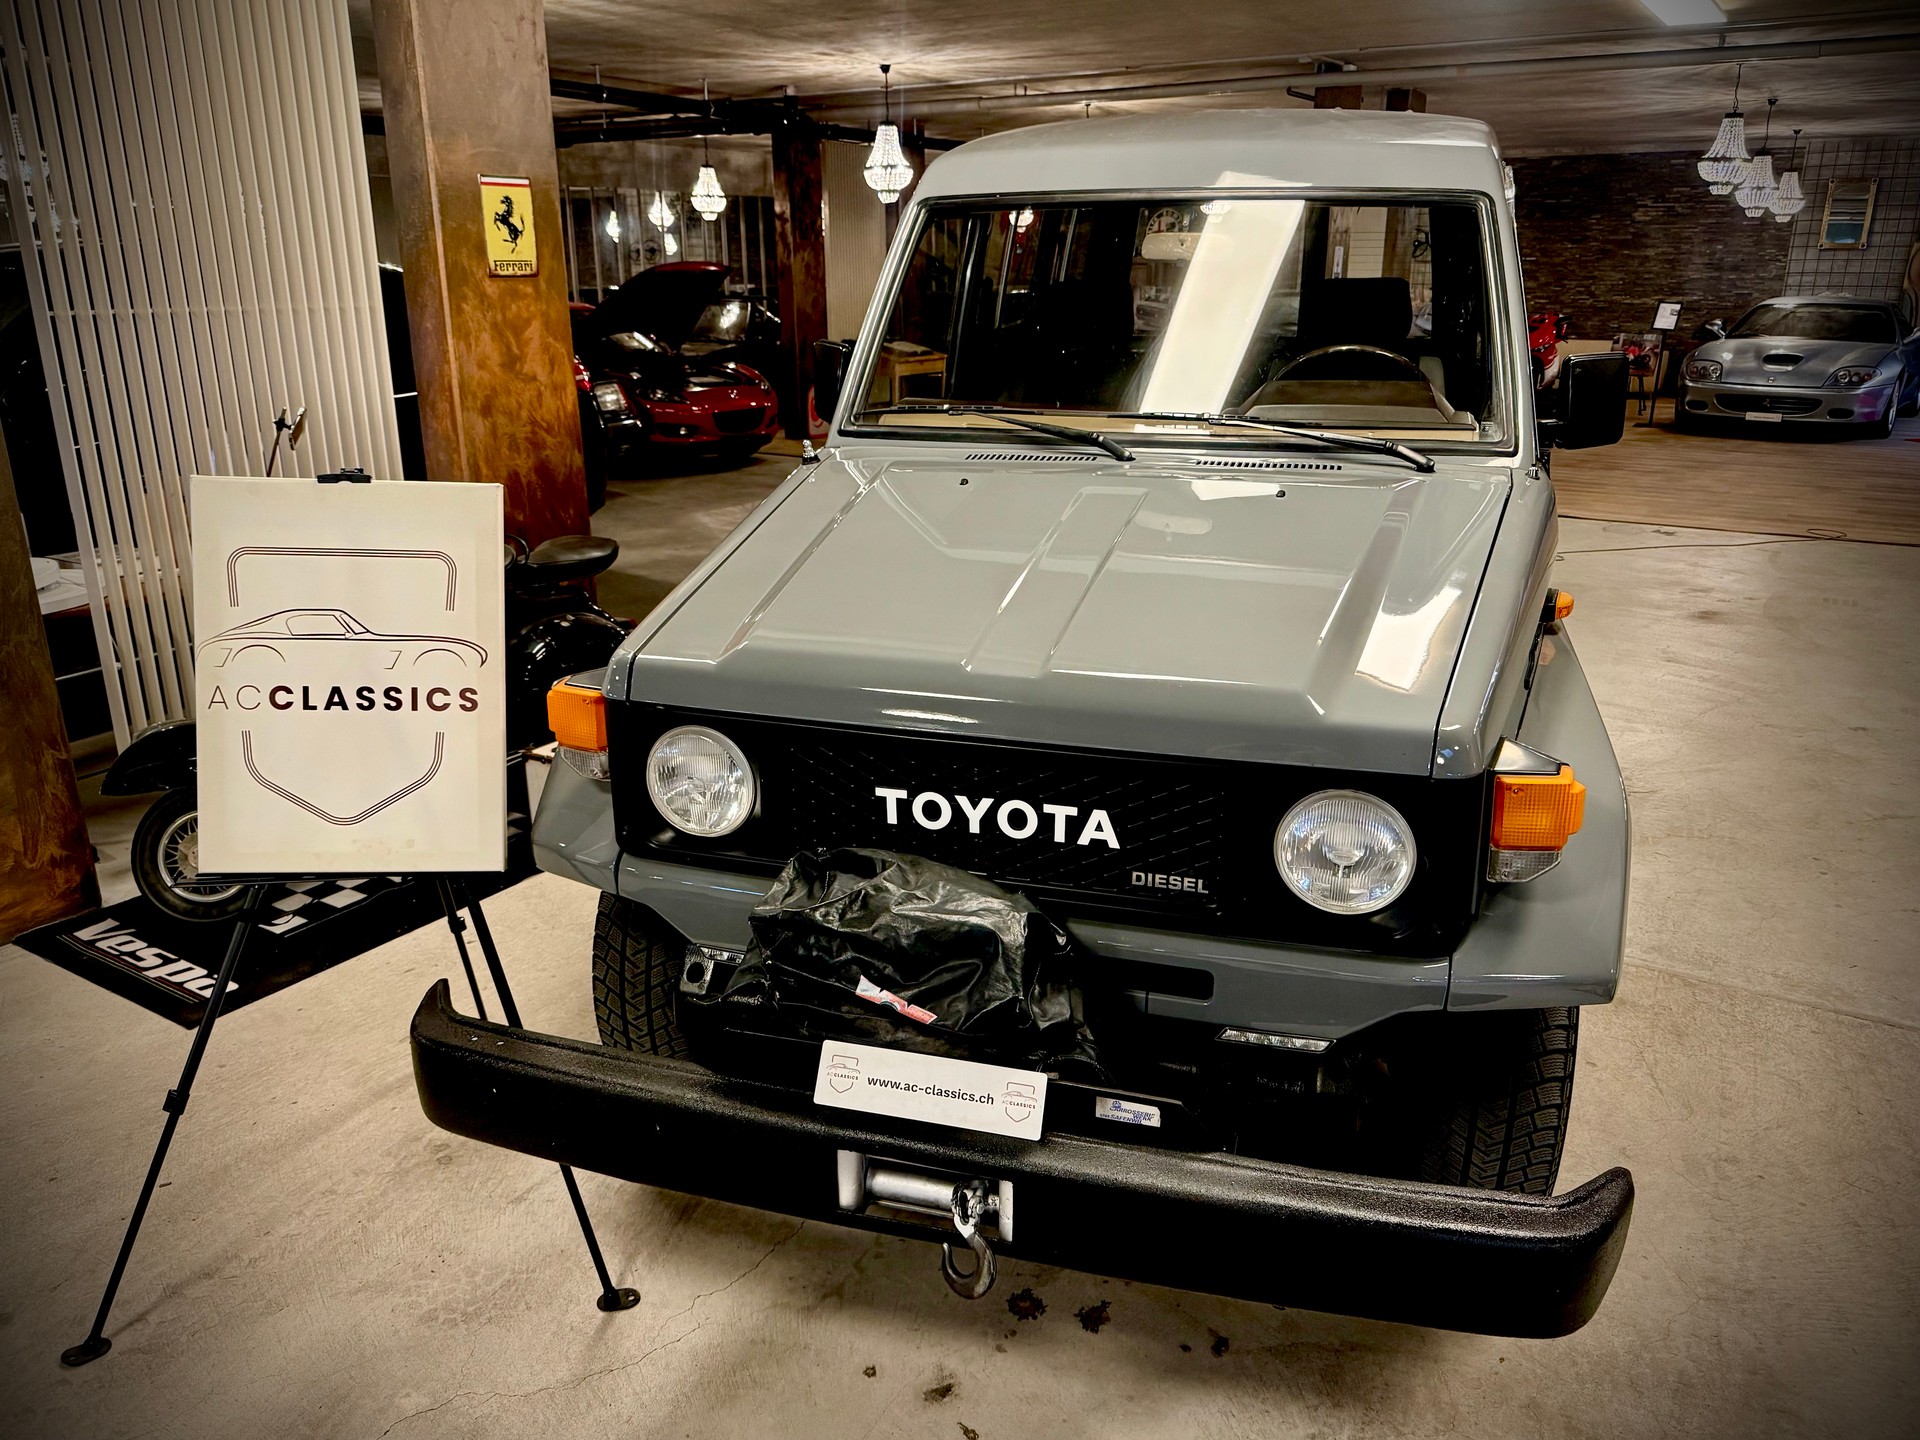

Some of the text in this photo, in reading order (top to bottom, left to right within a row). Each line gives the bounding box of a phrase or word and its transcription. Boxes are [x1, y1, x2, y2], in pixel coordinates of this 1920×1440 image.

[493, 260, 533, 272] Ferrari
[875, 787, 1120, 849] TOYOTA
[1132, 871, 1209, 894] DIESEL
[73, 918, 239, 998] Vespa
[867, 1076, 994, 1105] www.ac-classics.ch
